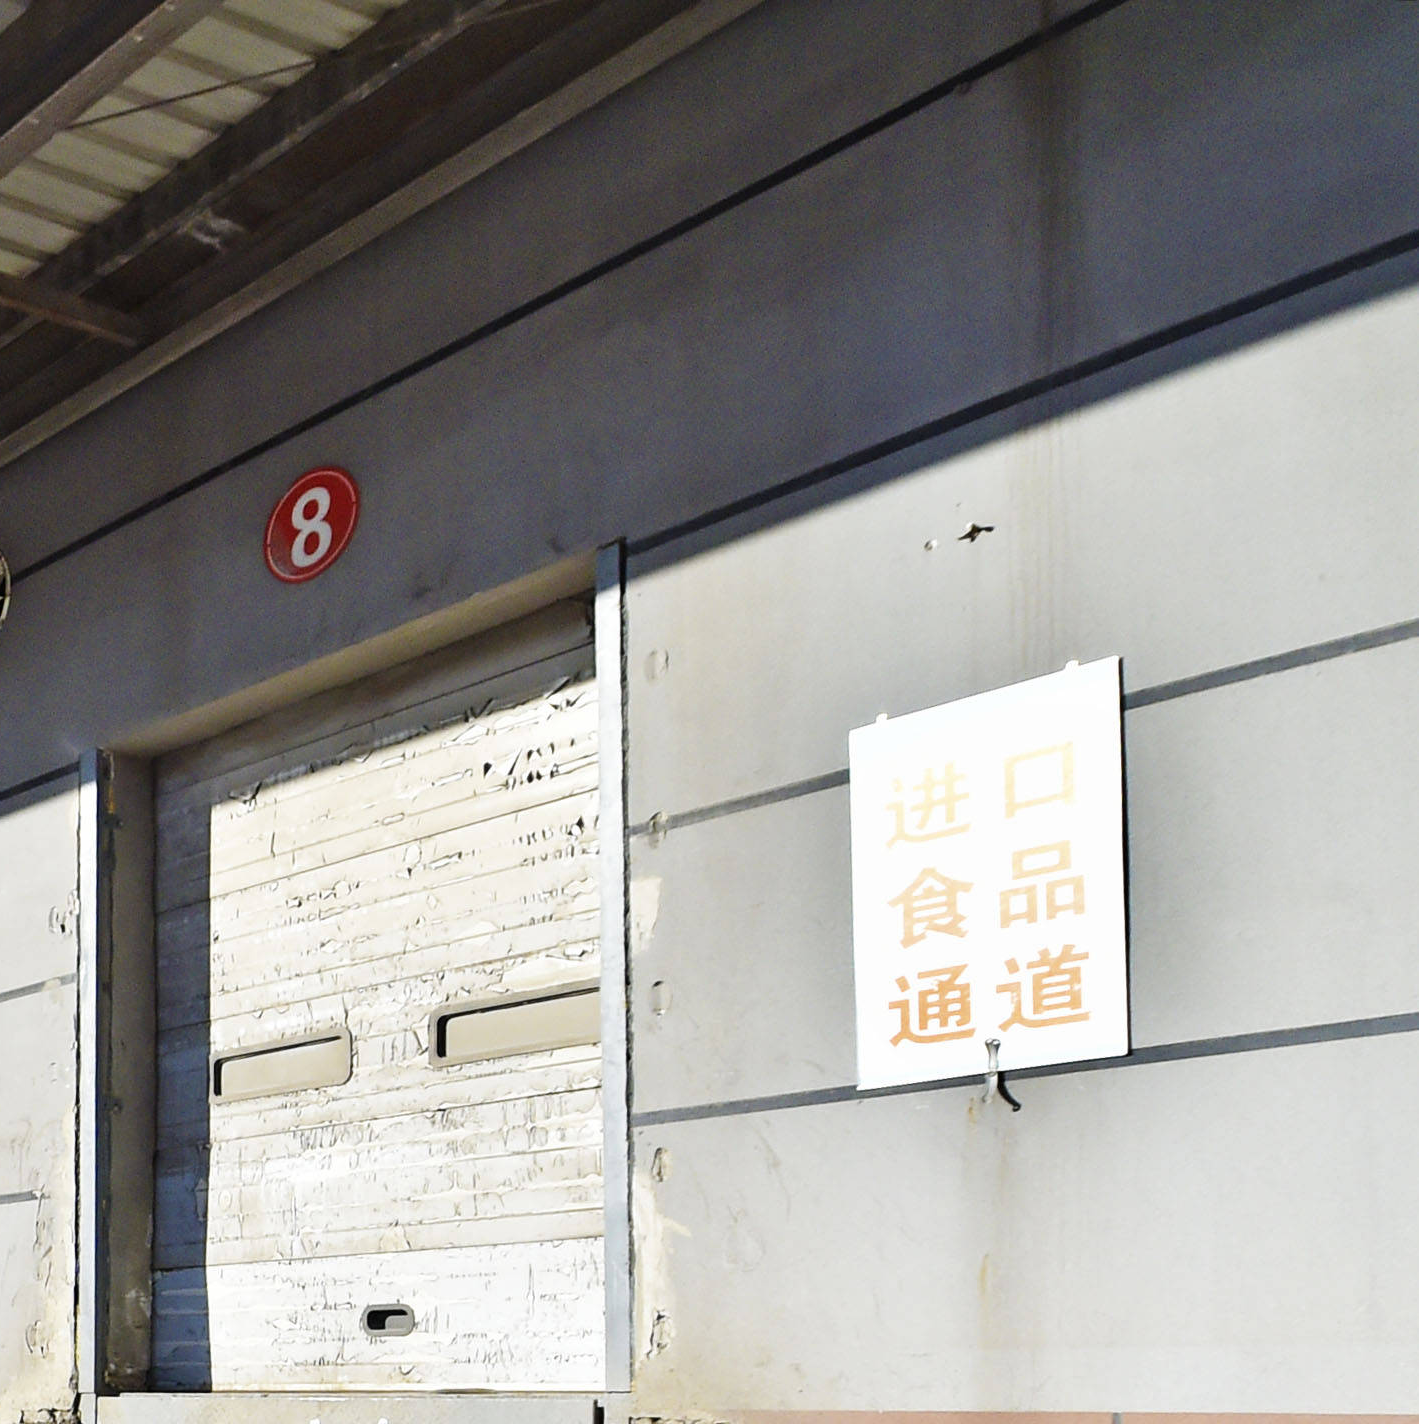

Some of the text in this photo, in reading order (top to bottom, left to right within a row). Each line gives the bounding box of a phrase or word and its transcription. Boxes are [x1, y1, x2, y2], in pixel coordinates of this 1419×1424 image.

[291, 487, 333, 568] 8
[885, 742, 1078, 849] 进口
[887, 839, 1086, 949] 食品
[888, 943, 1091, 1048] 通道
